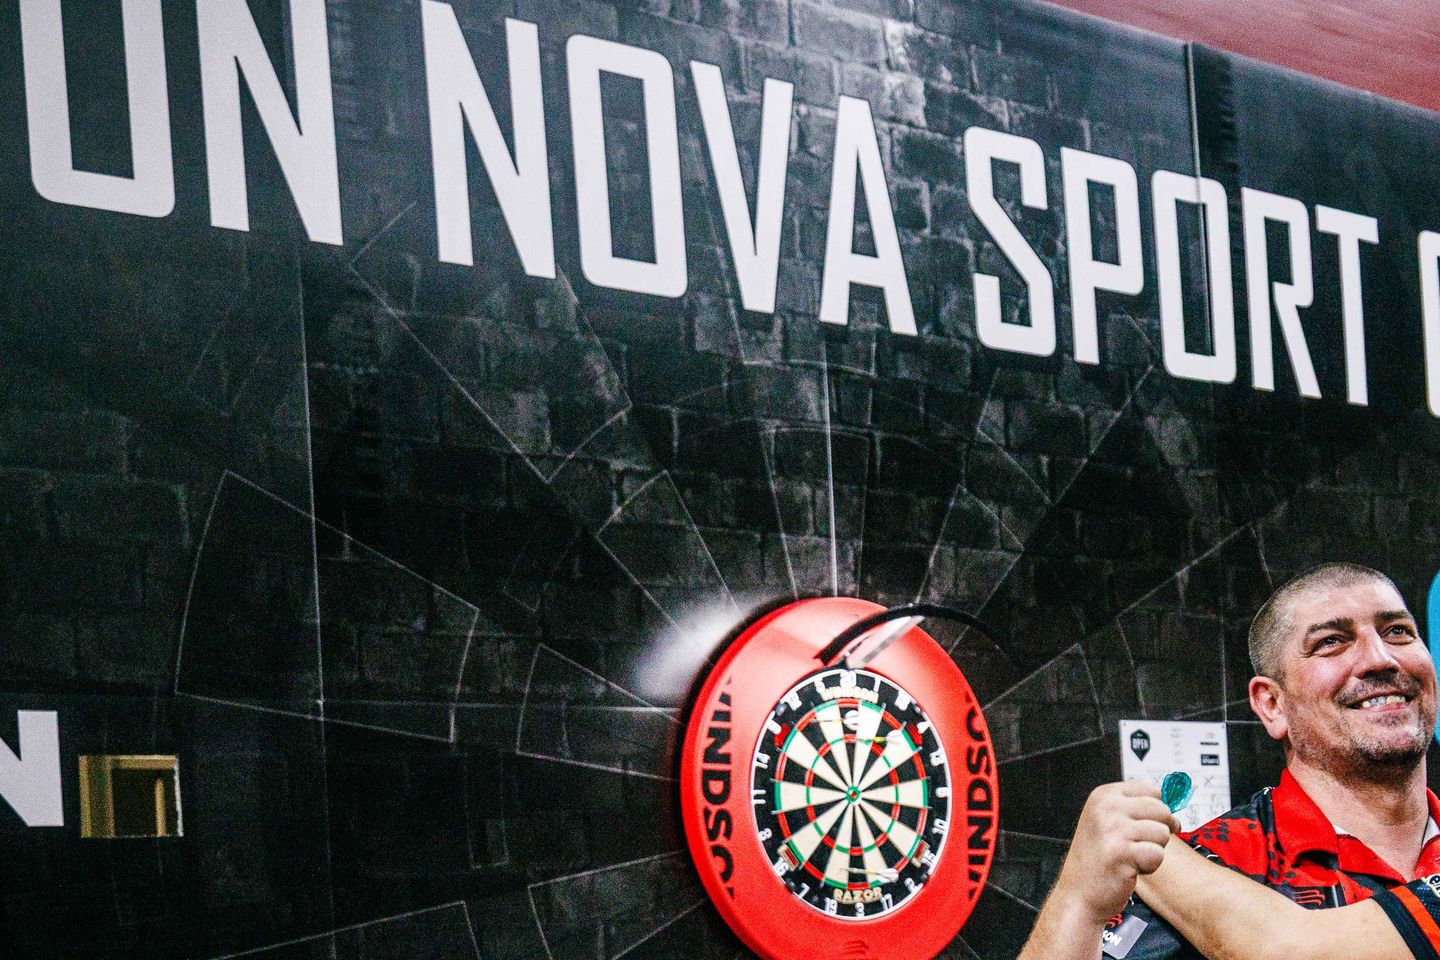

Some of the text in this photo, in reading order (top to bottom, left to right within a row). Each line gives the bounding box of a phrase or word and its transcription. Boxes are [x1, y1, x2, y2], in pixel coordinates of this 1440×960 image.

[421, 0, 918, 335] NOVA
[963, 126, 1379, 407] SPORT
[833, 886, 883, 904] RAZOR
